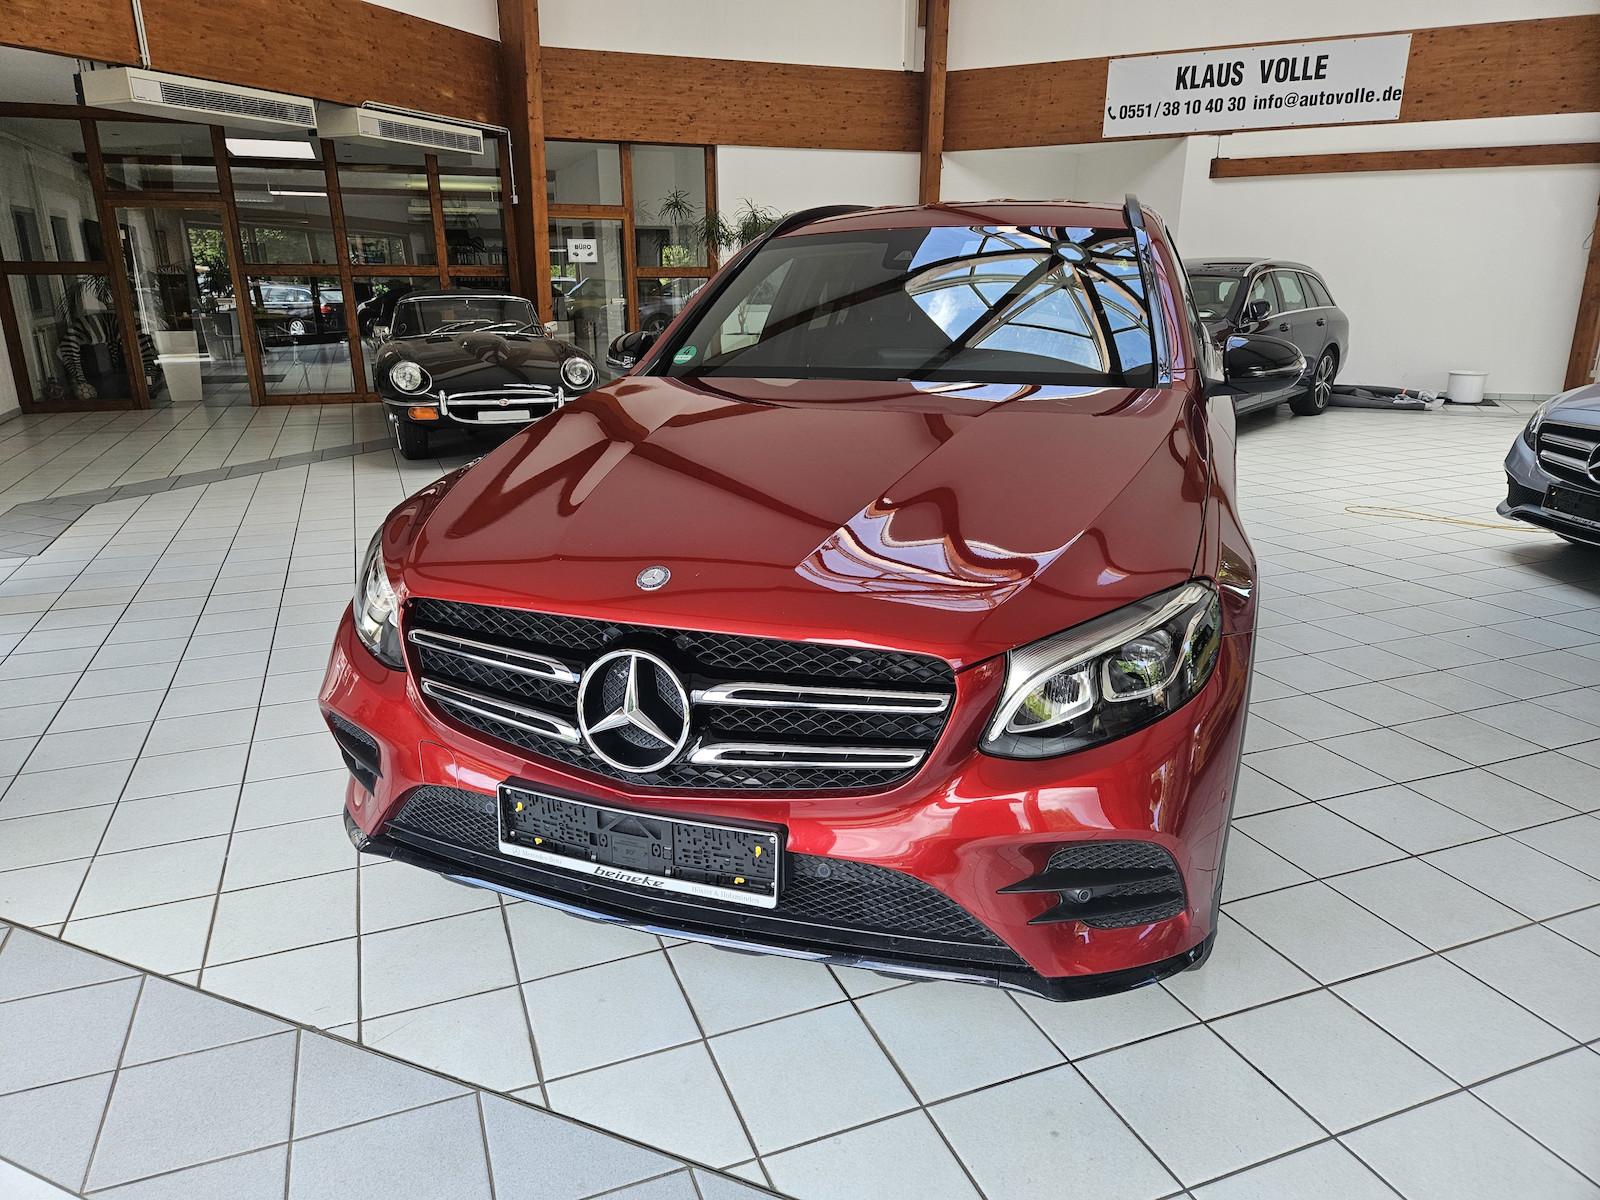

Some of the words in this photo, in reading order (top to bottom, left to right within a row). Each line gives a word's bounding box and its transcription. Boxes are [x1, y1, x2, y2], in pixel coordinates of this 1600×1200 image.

[1175, 60, 1245, 91] KLAUS
[1259, 54, 1329, 84] VOLLE
[1184, 98, 1201, 115] 10
[1204, 97, 1224, 114] 40
[1227, 95, 1246, 112] 30
[1252, 85, 1402, 110] info@autovolle.de
[593, 866, 665, 888] heineke
